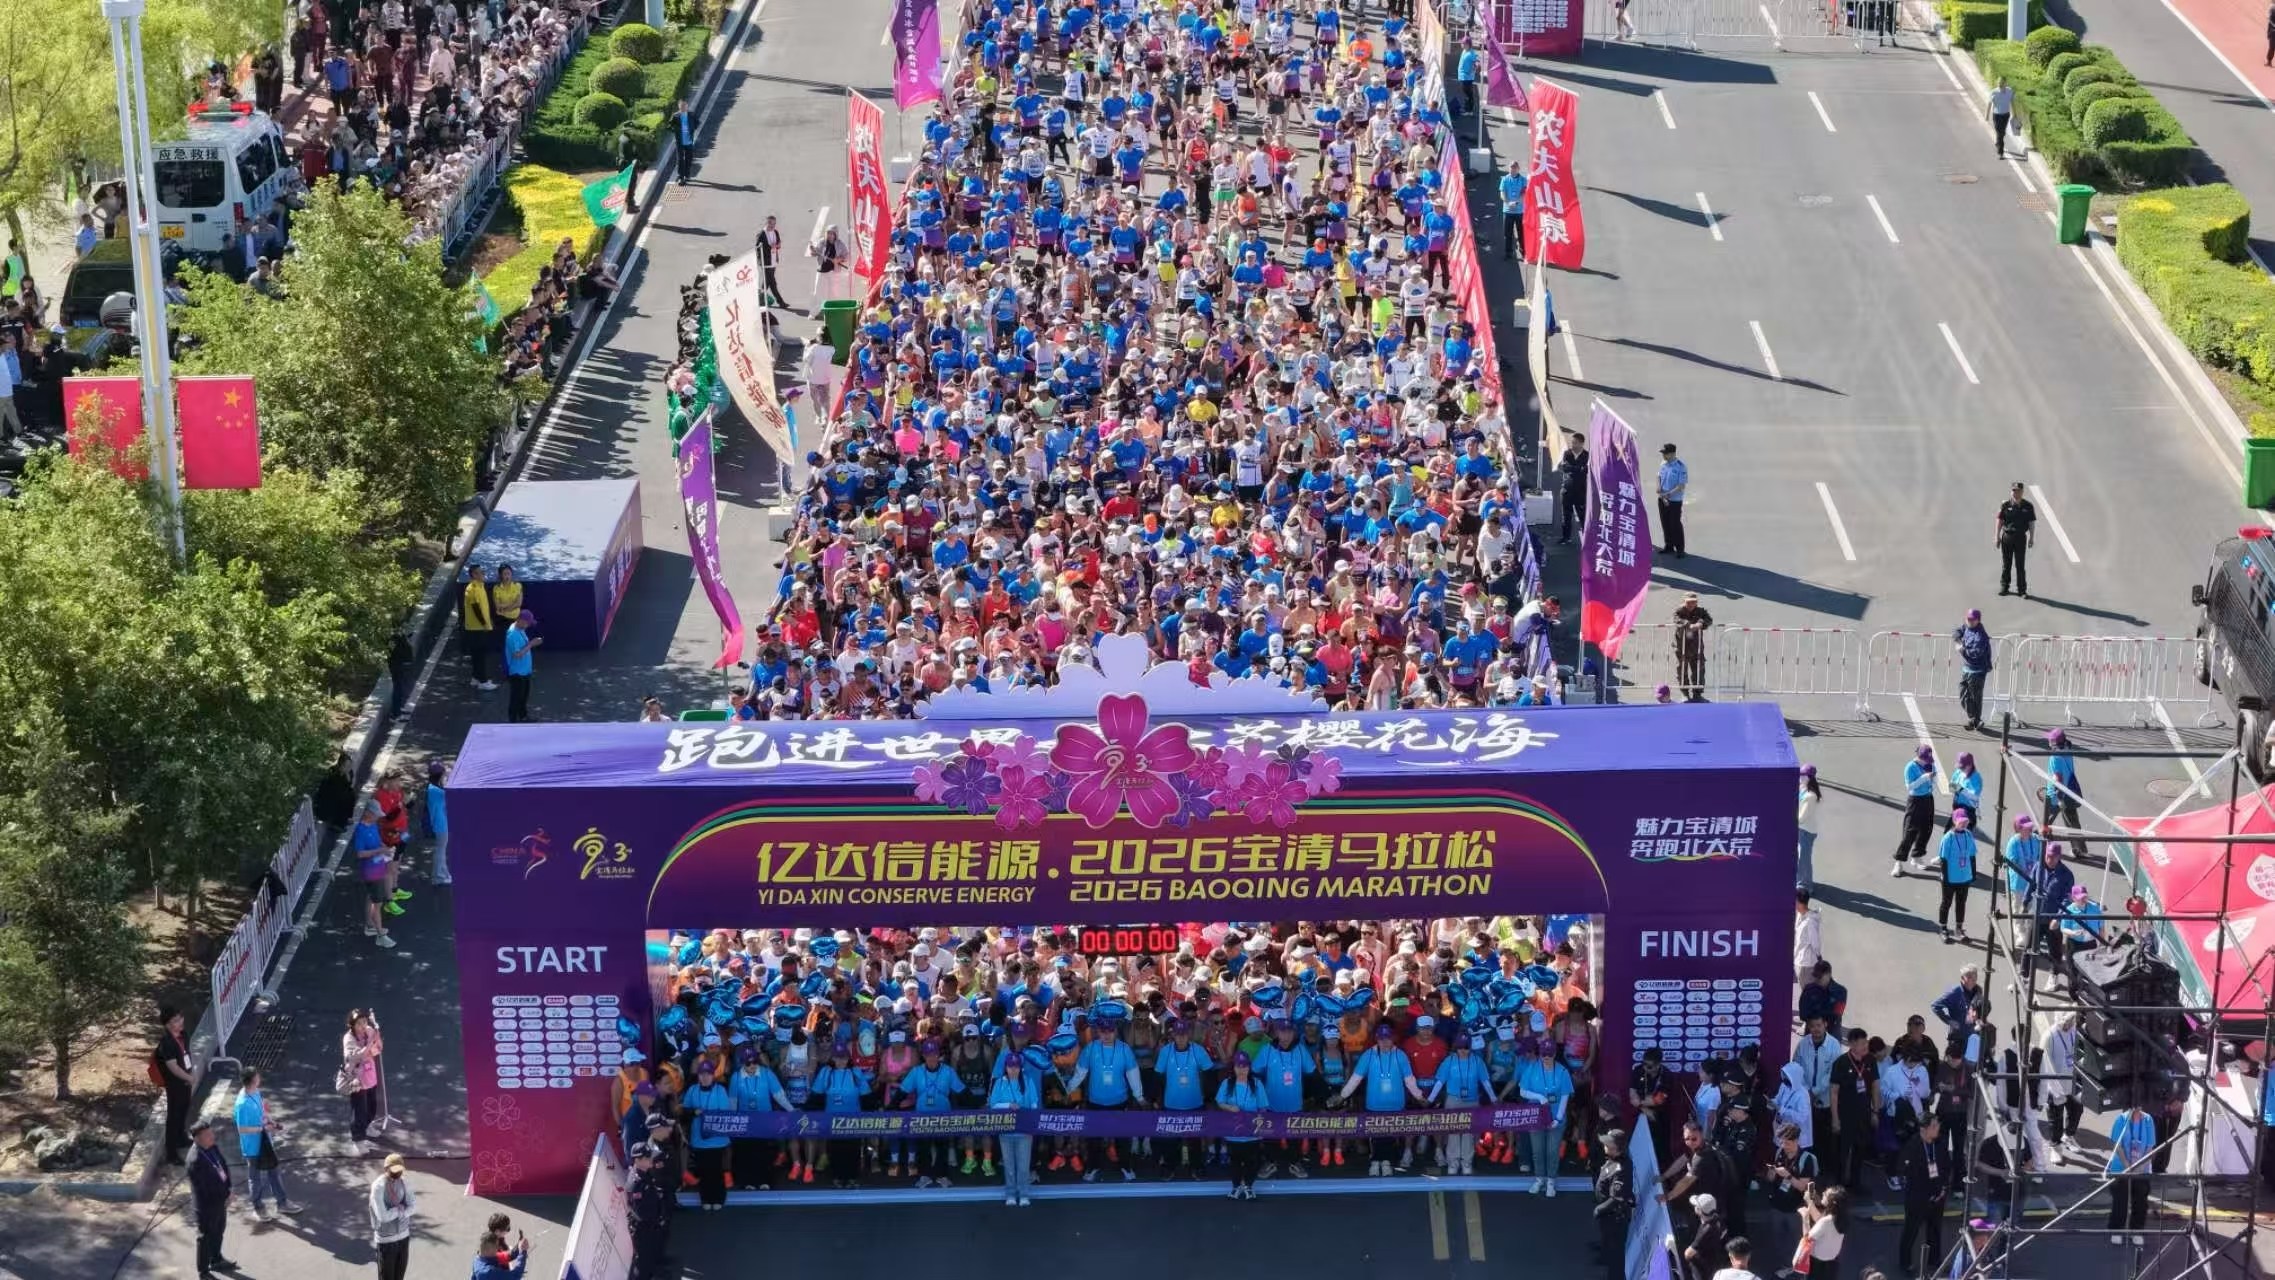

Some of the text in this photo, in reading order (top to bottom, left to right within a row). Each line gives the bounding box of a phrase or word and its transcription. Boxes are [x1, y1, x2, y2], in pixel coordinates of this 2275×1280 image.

[159, 148, 219, 160] 应急救援
[1530, 109, 1571, 245] 农夫山泉
[1617, 481, 1637, 568] 魅力宝清城
[1634, 815, 1759, 836] 魅力宝清城
[1629, 837, 1754, 858] 奔跑北大荒
[758, 886, 1036, 905] YI DA XIN CONSERVE ENERGY
[1070, 874, 1491, 902] 2026 BAOQING MARATHON
[1641, 929, 1759, 957] FINISH
[496, 945, 608, 974] START
